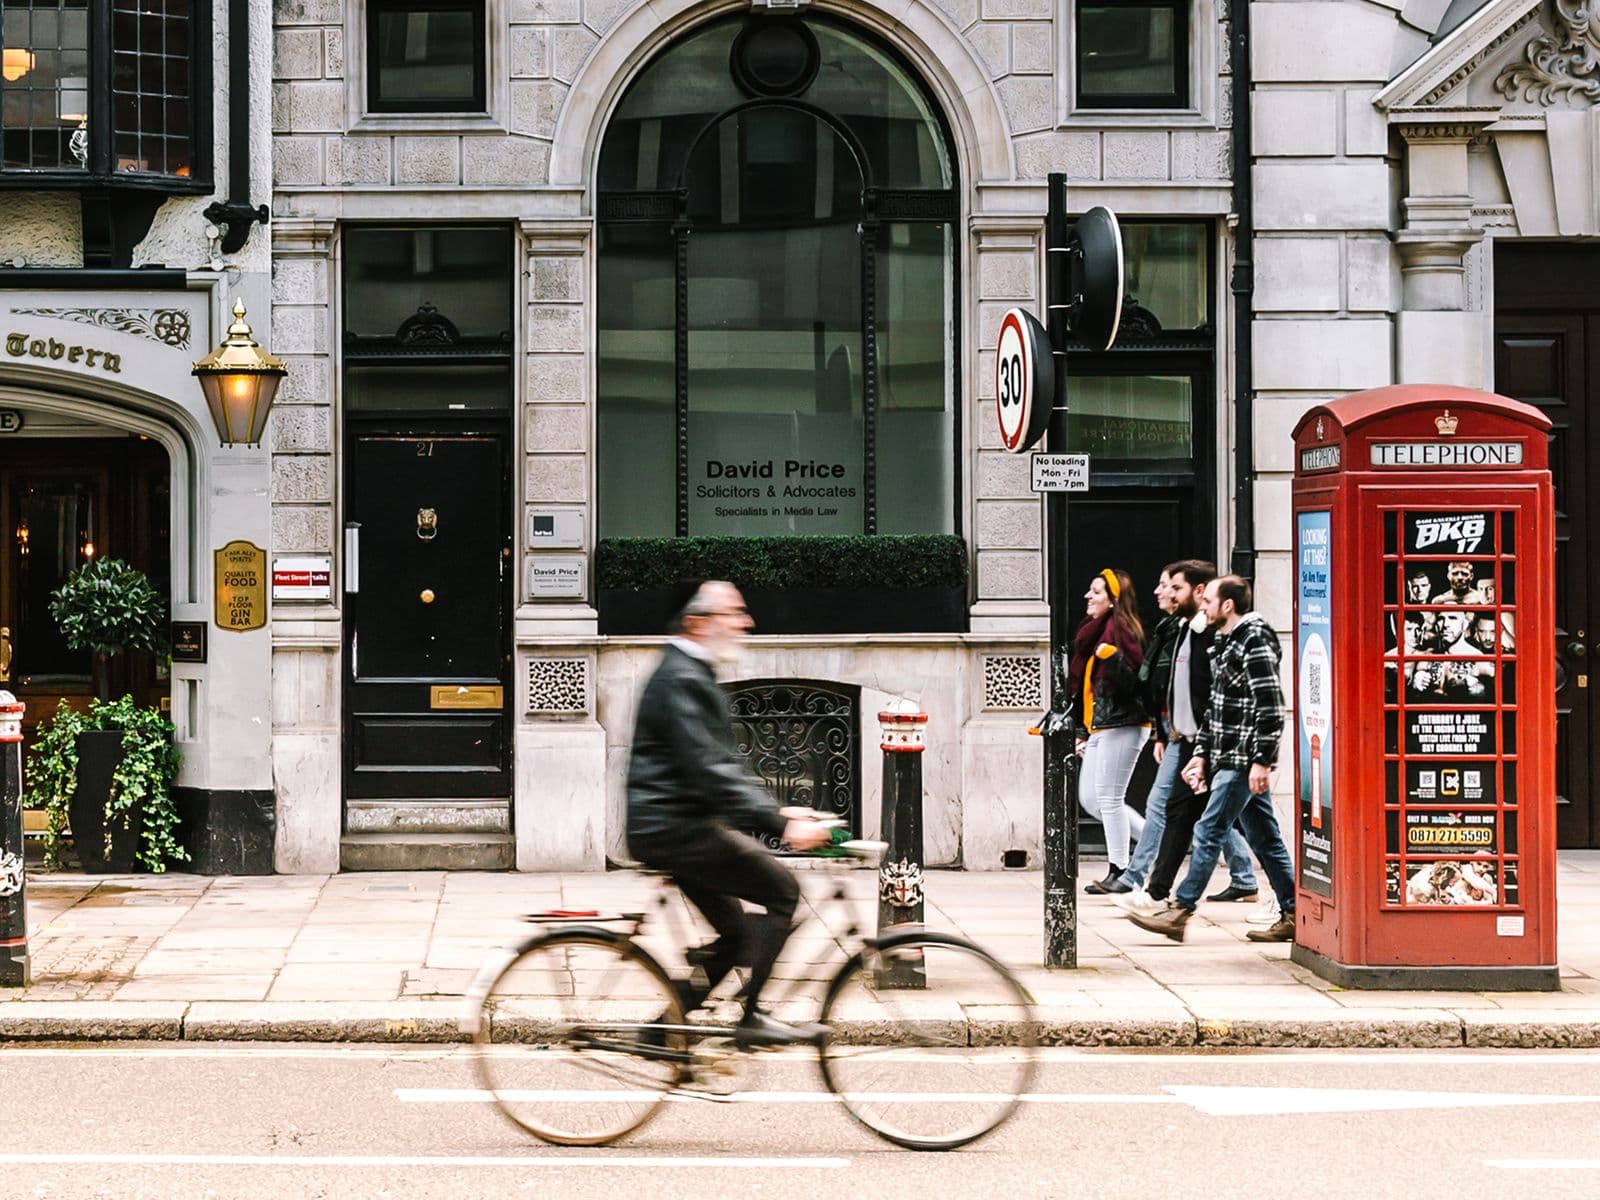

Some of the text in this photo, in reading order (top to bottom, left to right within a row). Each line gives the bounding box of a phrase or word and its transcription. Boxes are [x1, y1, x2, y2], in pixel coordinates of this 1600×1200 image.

[6, 332, 122, 373] Tavern
[1000, 354, 1021, 408] 30
[1375, 445, 1517, 464] TELEPHONE
[1036, 457, 1086, 467] No loading
[706, 460, 845, 479] David Price
[1041, 469, 1061, 477] Mon
[1068, 469, 1081, 477] Fri
[696, 484, 857, 498] Solicitors & Advocates
[714, 506, 838, 518] Specialists in Media Law
[1302, 528, 1327, 545] LOOKING
[1415, 519, 1485, 549] BKB
[1456, 537, 1482, 554] 17
[224, 571, 256, 579] QUALITY
[534, 568, 579, 576] David Price
[224, 577, 257, 587] FOOD
[230, 609, 251, 618] GIN
[230, 618, 251, 626] BAR
[1410, 829, 1491, 842] 0871 271 5599
